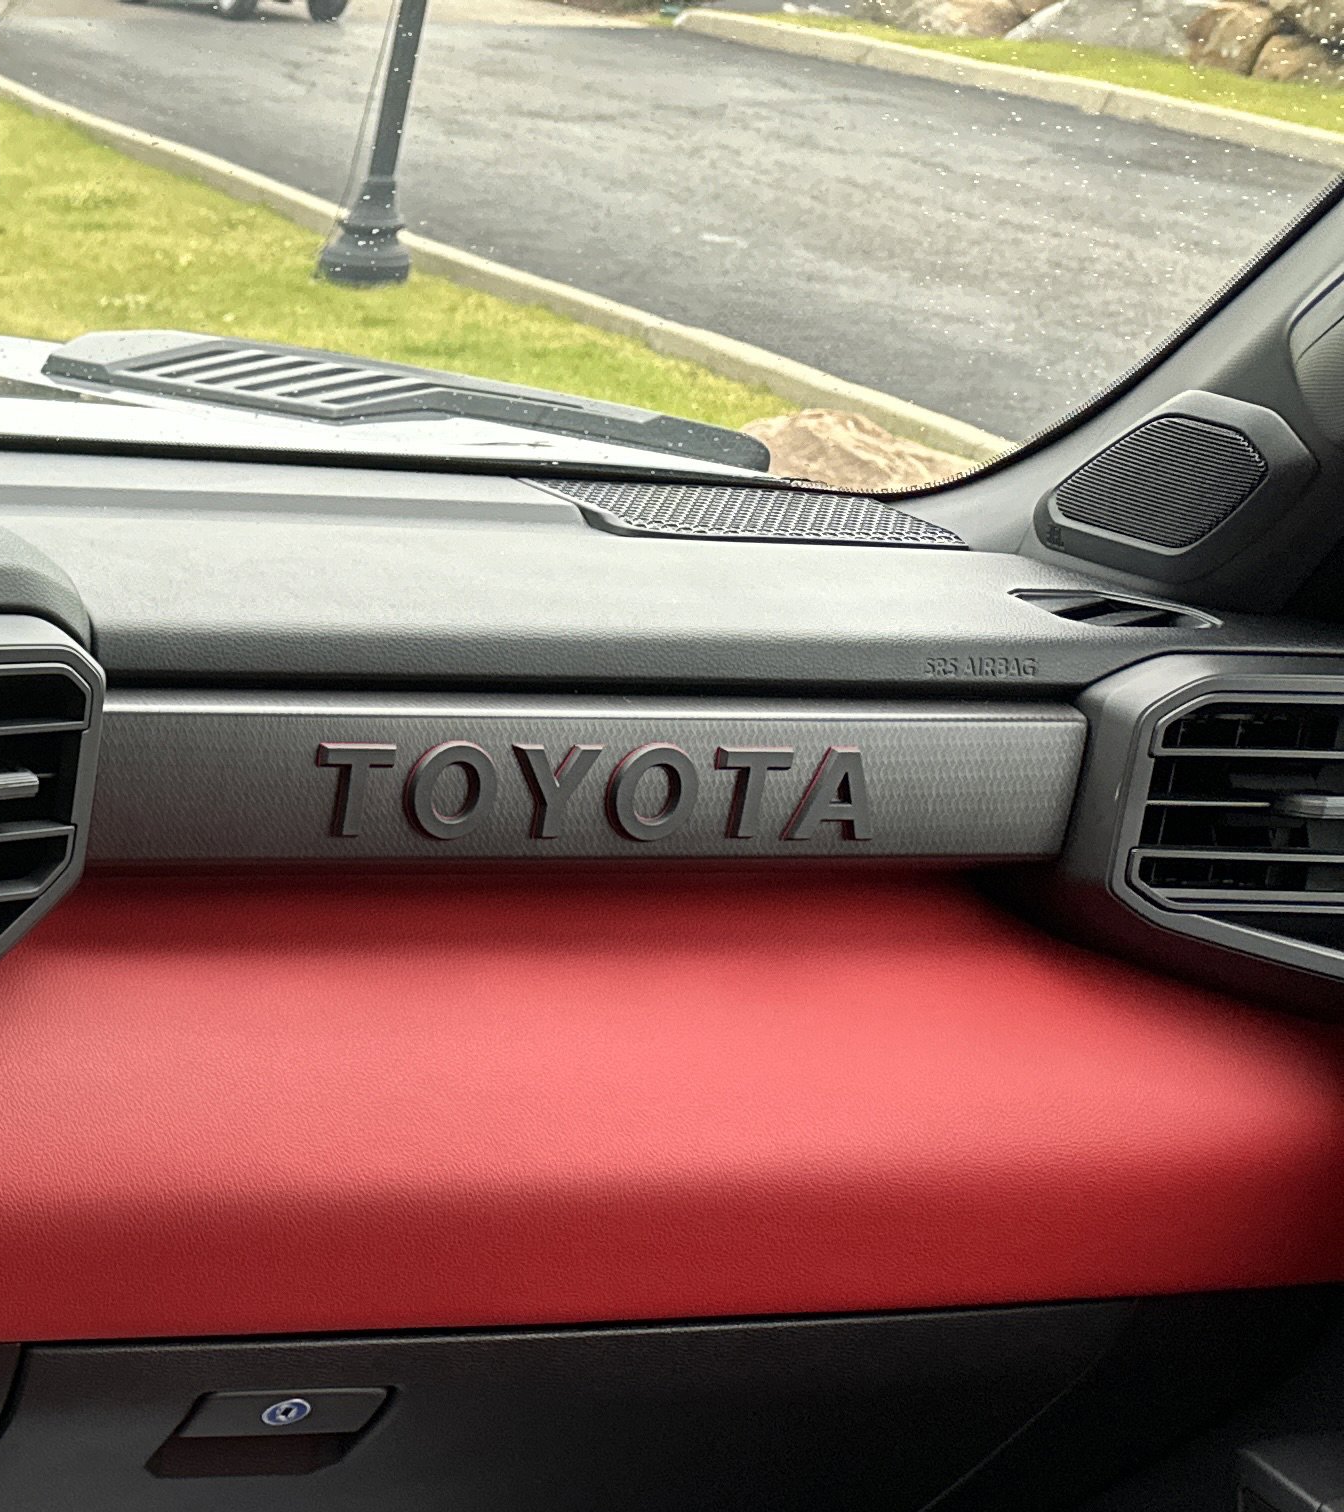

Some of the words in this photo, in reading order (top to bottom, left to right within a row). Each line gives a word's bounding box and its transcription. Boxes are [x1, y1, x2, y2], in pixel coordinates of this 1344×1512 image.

[923, 655, 961, 678] SRS
[963, 655, 1038, 679] AIRBAG
[315, 739, 874, 842] TOYOTA
